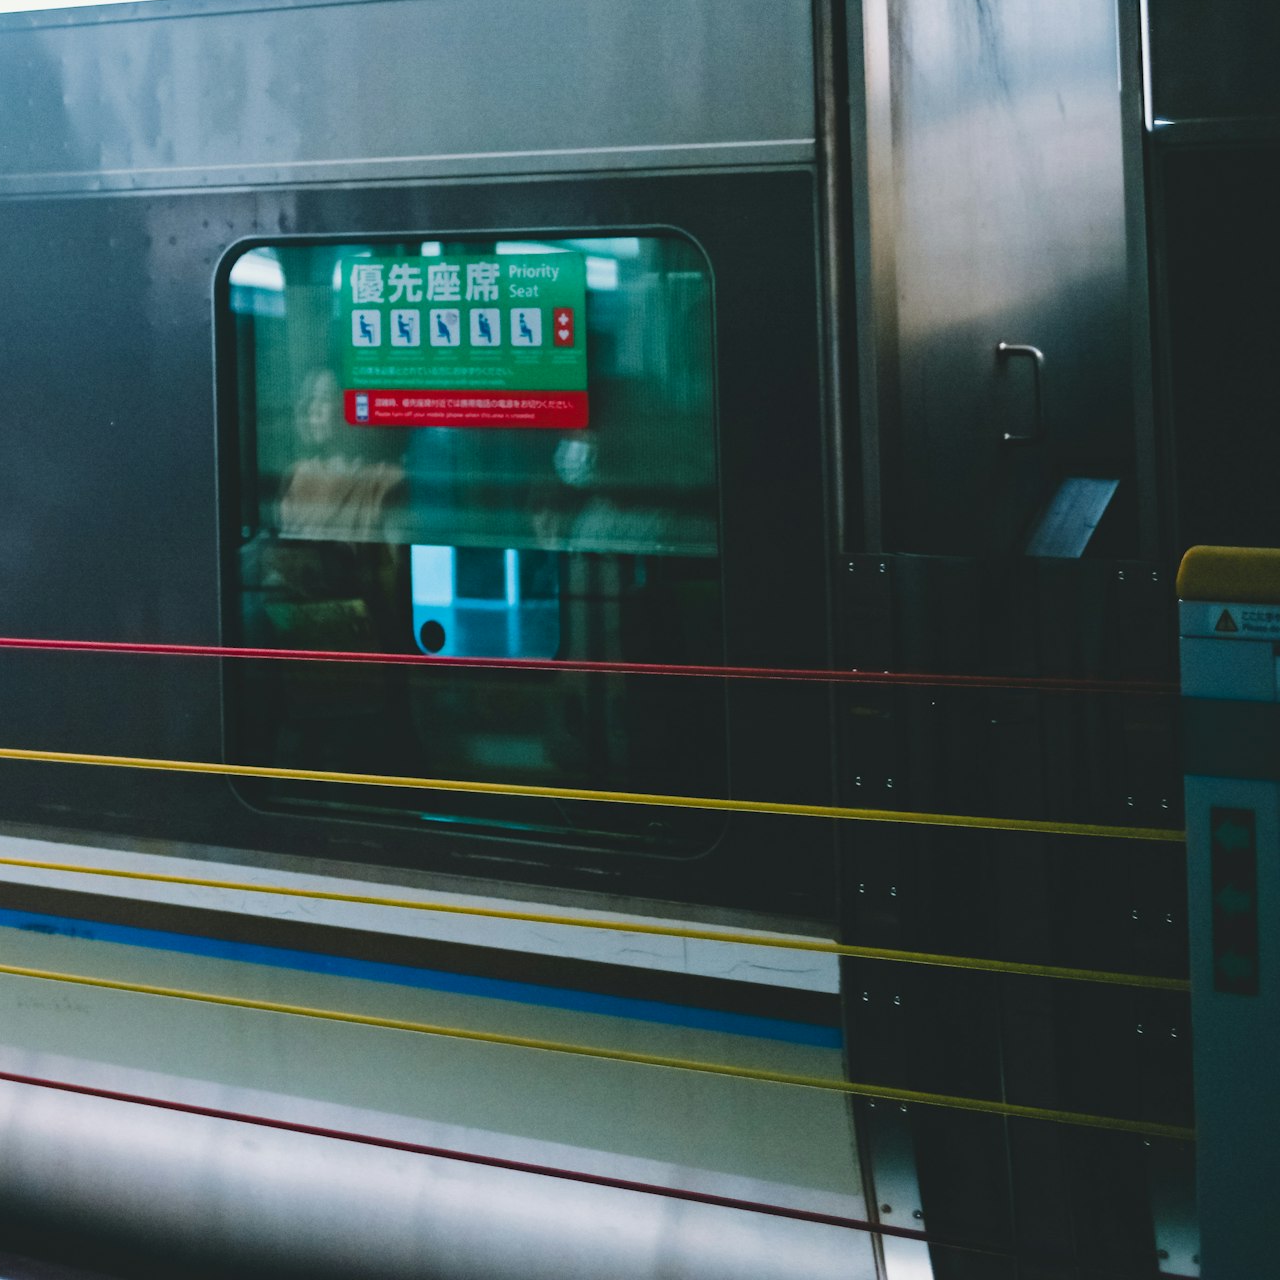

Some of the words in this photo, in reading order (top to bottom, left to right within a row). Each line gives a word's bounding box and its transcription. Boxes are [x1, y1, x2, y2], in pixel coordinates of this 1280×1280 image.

[509, 265, 560, 281] Priority
[350, 263, 501, 303] 優先座席
[509, 284, 539, 298] Seat
